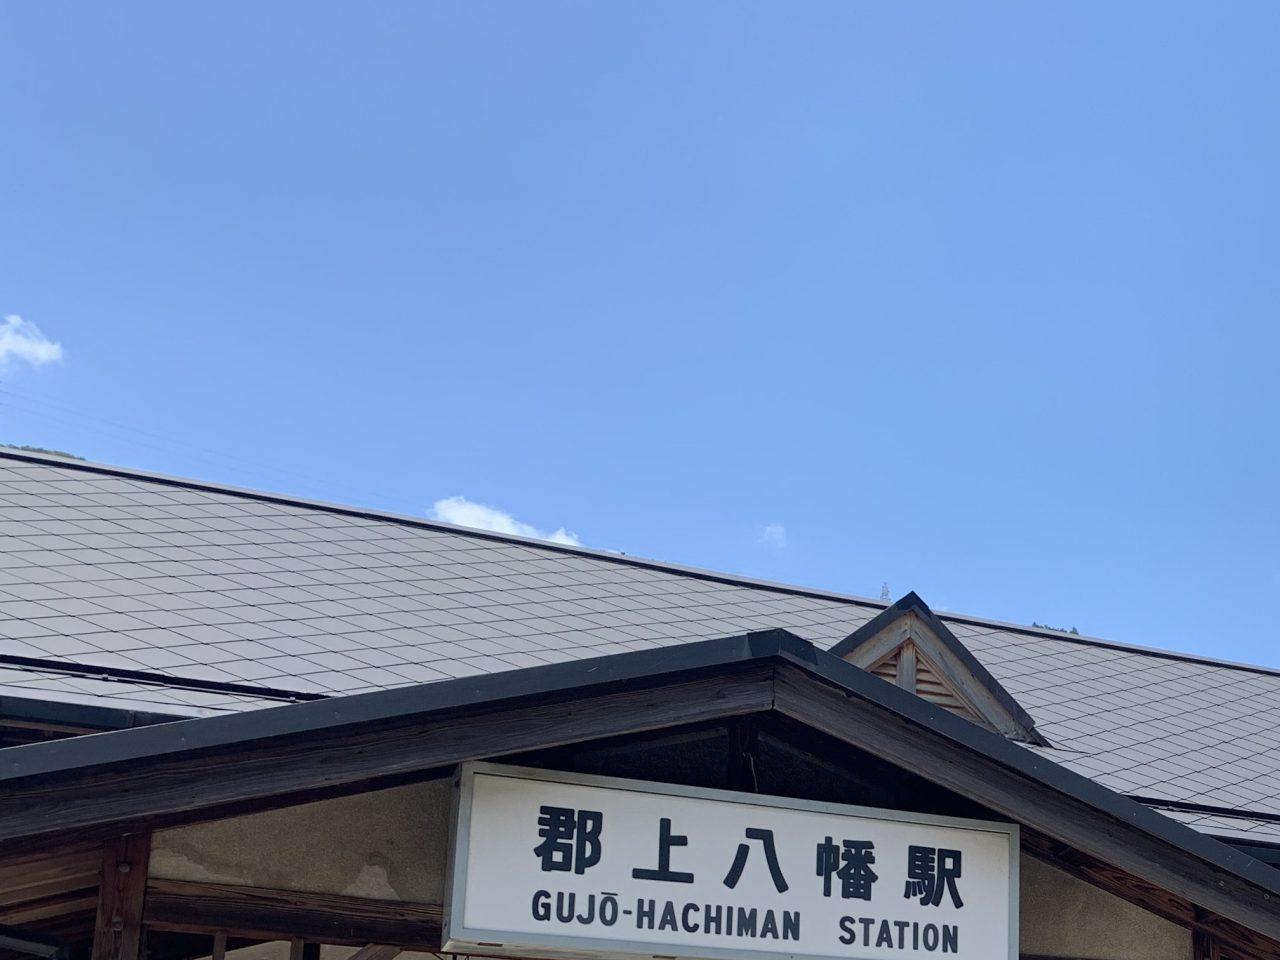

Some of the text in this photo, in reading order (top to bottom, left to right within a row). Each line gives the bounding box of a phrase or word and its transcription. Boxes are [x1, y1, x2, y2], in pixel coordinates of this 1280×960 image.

[533, 805, 965, 910] 郡上八幡駅
[838, 915, 959, 954] STATION
